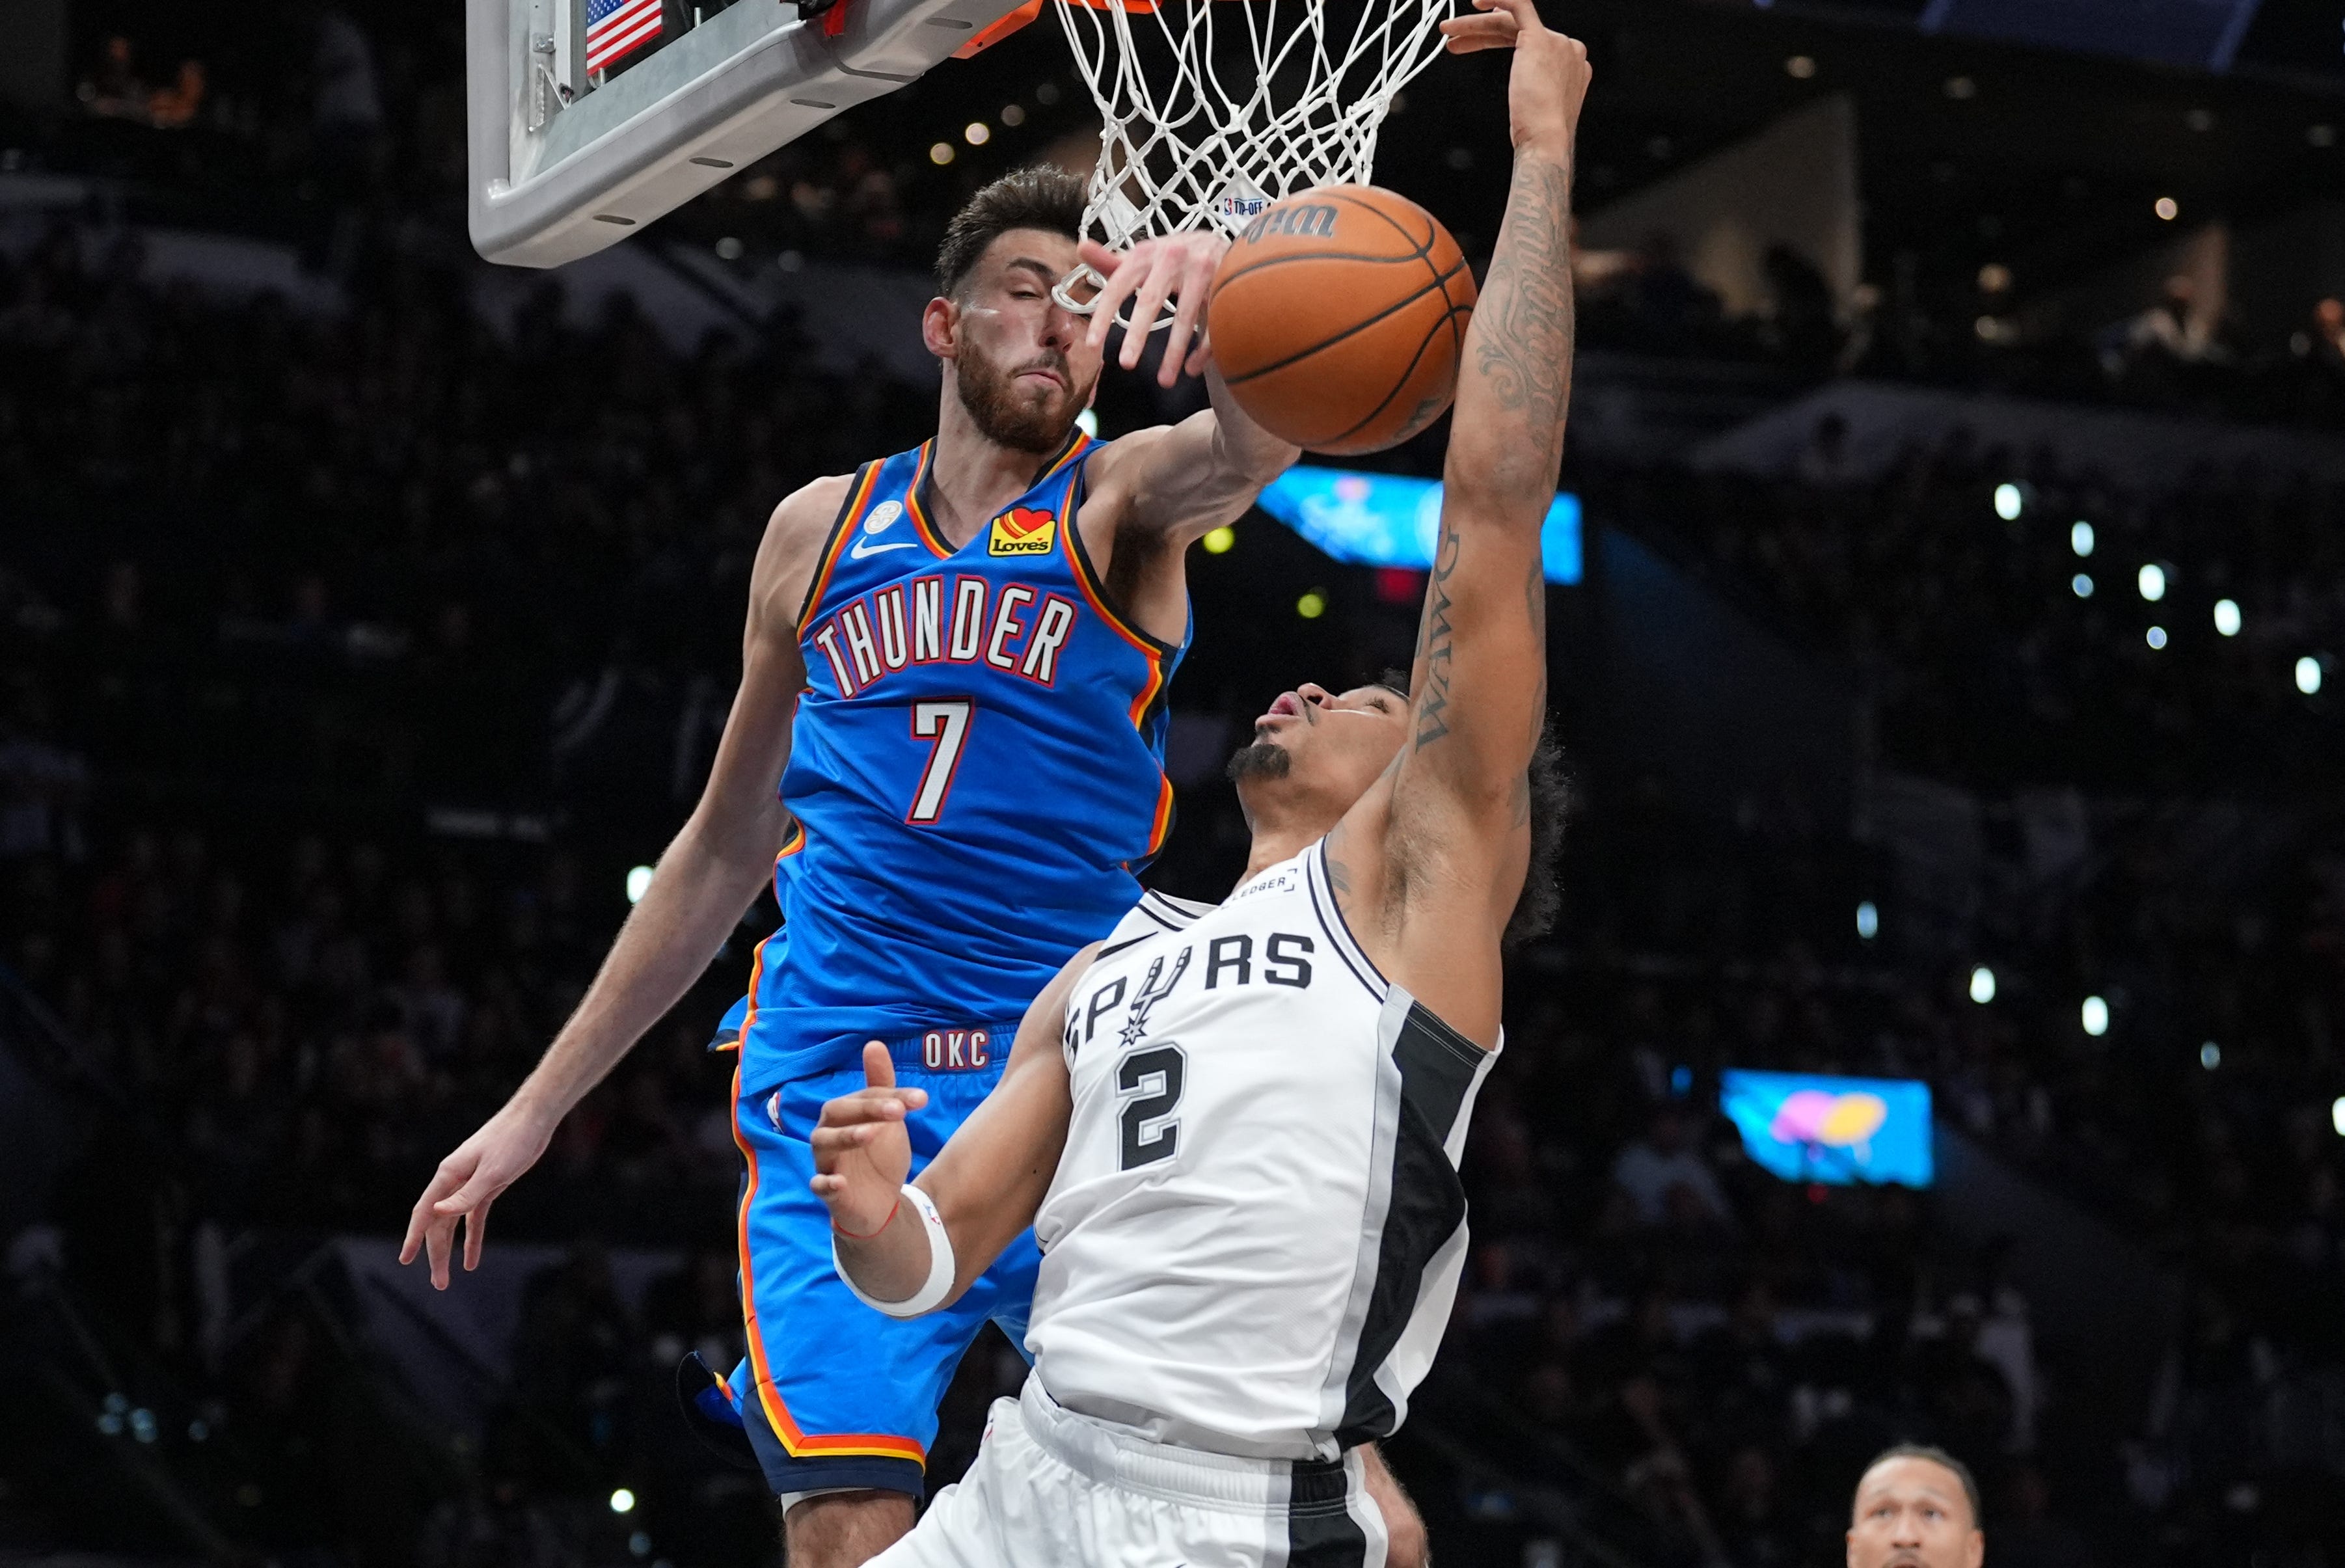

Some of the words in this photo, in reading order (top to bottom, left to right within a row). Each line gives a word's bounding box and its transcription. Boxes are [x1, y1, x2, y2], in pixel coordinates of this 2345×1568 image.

[1234, 200, 1263, 216] TIP-OFF
[813, 574, 1078, 700] THUNDER
[905, 696, 975, 825] 7
[922, 1029, 989, 1071] OKC
[1115, 1040, 1188, 1172] 2
